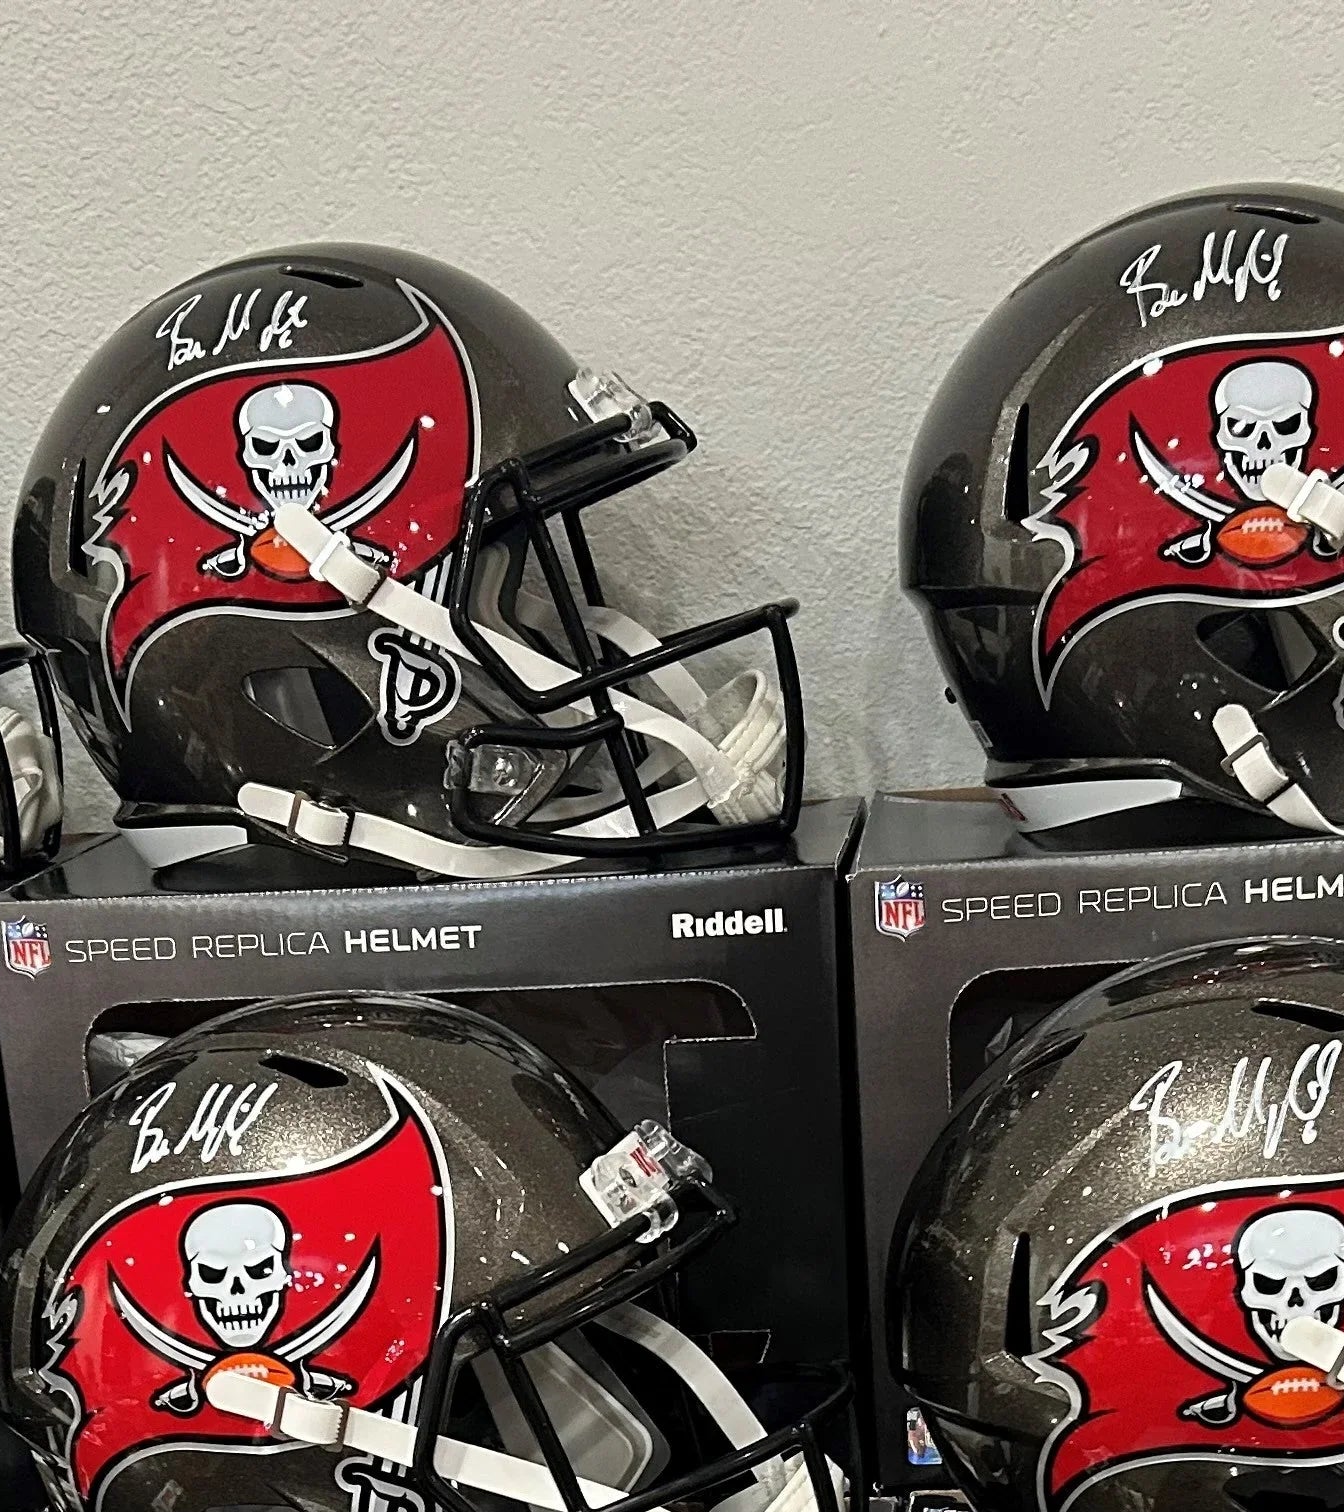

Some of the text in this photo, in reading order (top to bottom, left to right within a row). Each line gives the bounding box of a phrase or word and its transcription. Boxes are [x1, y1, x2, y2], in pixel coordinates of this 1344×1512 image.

[884, 902, 925, 930] NFL
[941, 892, 1062, 923] SPEED
[1079, 881, 1228, 914] REPLICA
[671, 908, 788, 939] Riddell
[13, 941, 52, 967] NFL
[64, 924, 482, 964] SPEED REPLICA HELMET
